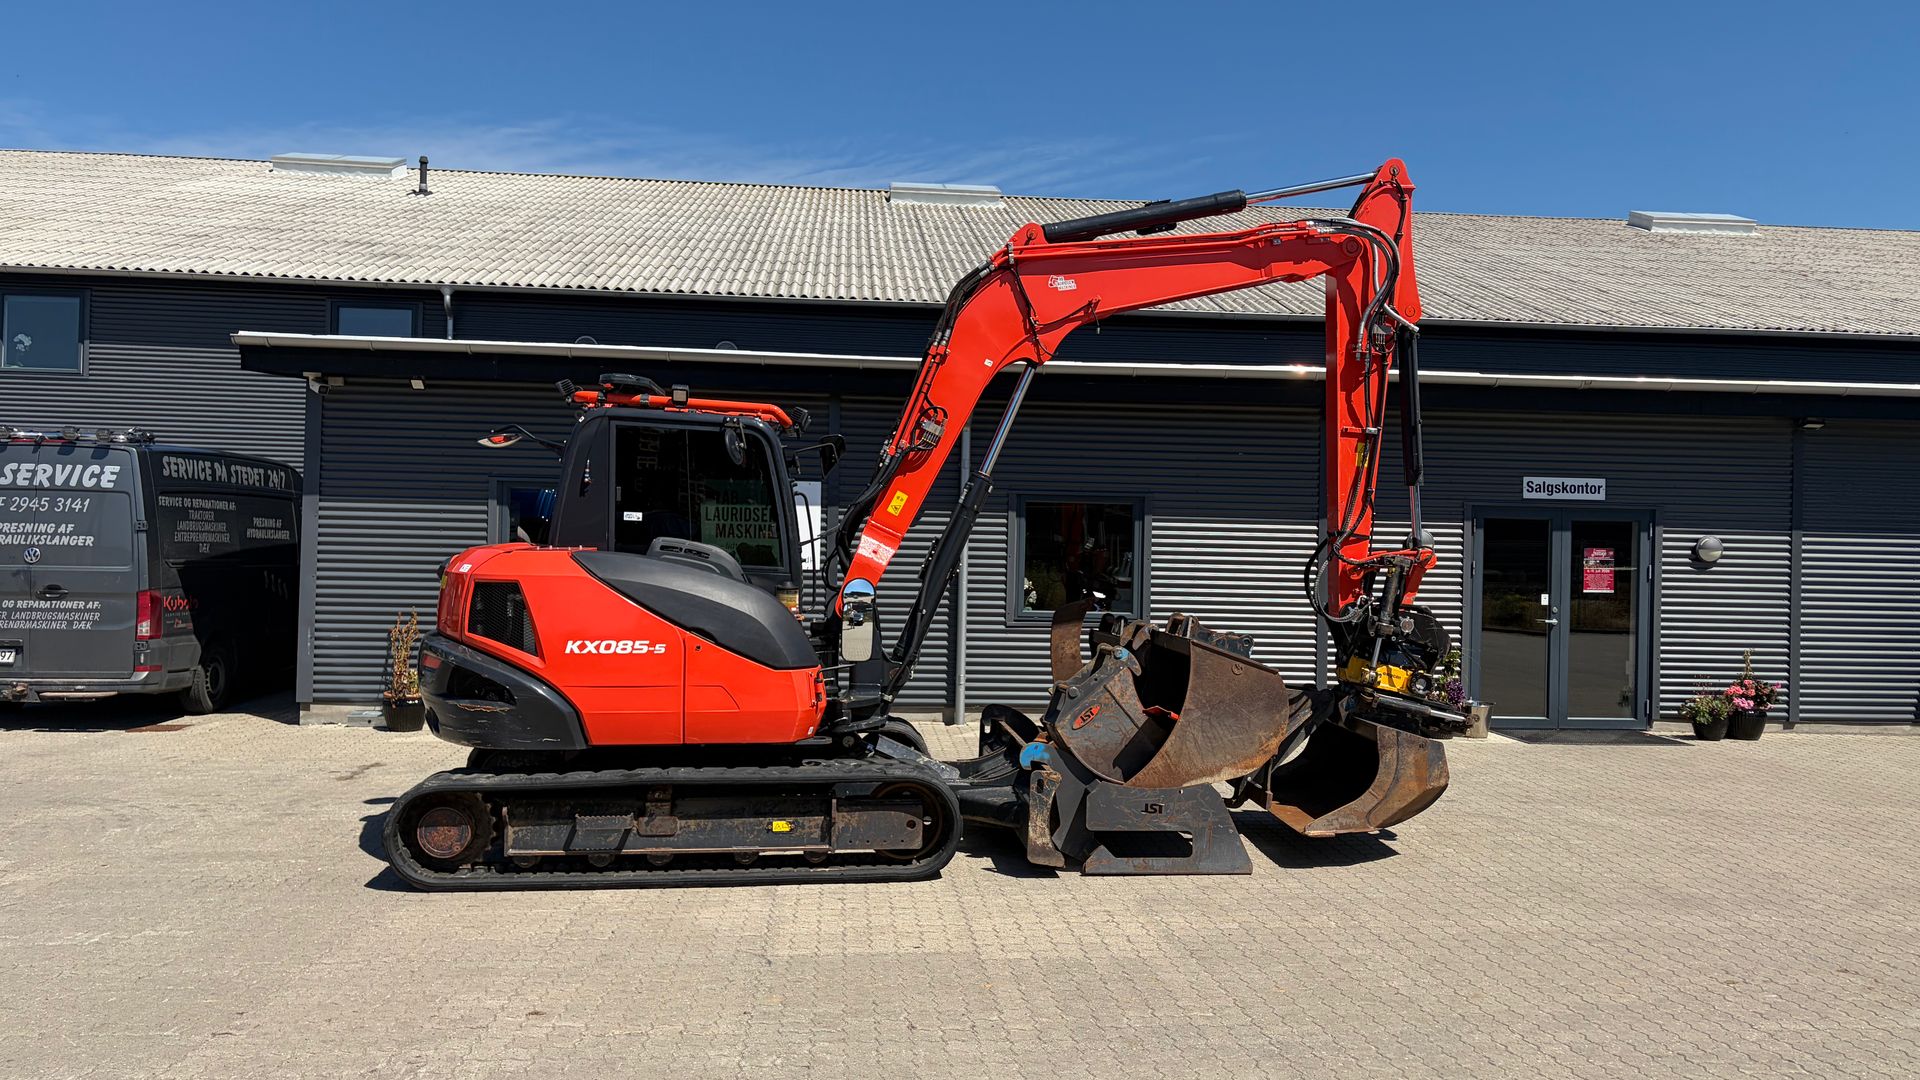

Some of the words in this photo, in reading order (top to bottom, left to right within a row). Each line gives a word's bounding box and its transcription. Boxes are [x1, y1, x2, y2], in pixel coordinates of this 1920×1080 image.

[0, 462, 121, 489] SERVICE
[162, 455, 213, 482] SERVICE
[230, 464, 265, 488] STEDET
[267, 468, 286, 491] 24/7
[1526, 480, 1603, 496] Salgskontor
[9, 496, 50, 513] 2945
[54, 497, 91, 513] 3141
[158, 495, 183, 508] SERVICE
[183, 498, 192, 508] OG
[57, 523, 75, 534] AF
[2, 600, 15, 609] OG
[16, 600, 85, 610] REPARATIONER
[11, 611, 101, 621] LANDBRUGSMASKINER
[72, 620, 93, 630] DÆK
